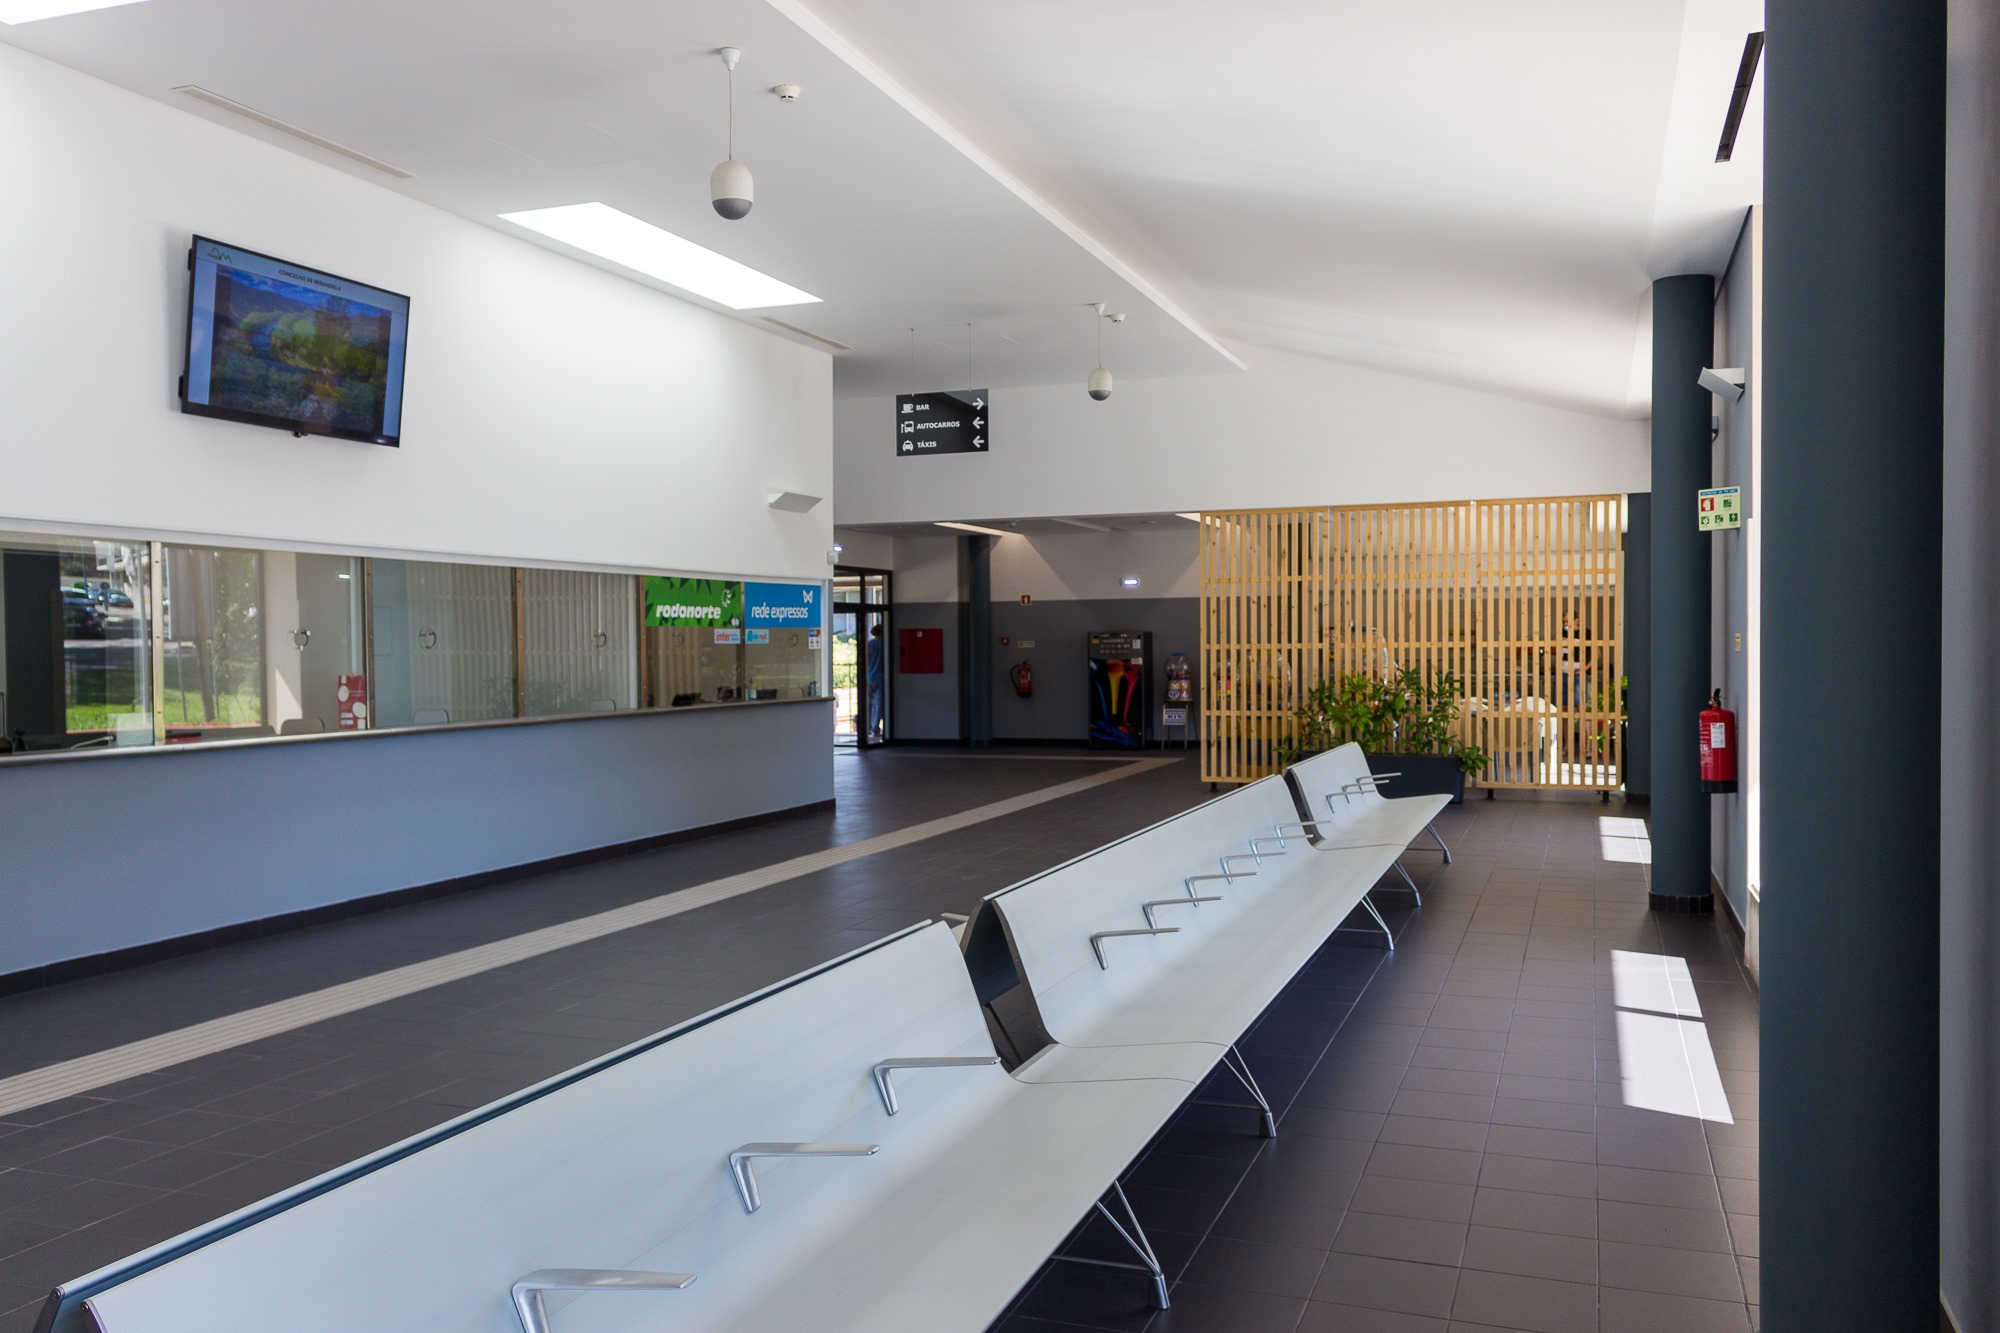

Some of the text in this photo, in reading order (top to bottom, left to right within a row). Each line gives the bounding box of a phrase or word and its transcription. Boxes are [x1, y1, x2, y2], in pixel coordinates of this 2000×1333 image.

[916, 421, 961, 430] AUTOCARROS
[917, 440, 937, 448] TÁXIS
[655, 603, 722, 619] rodonorte
[751, 602, 809, 623] rede expressos
